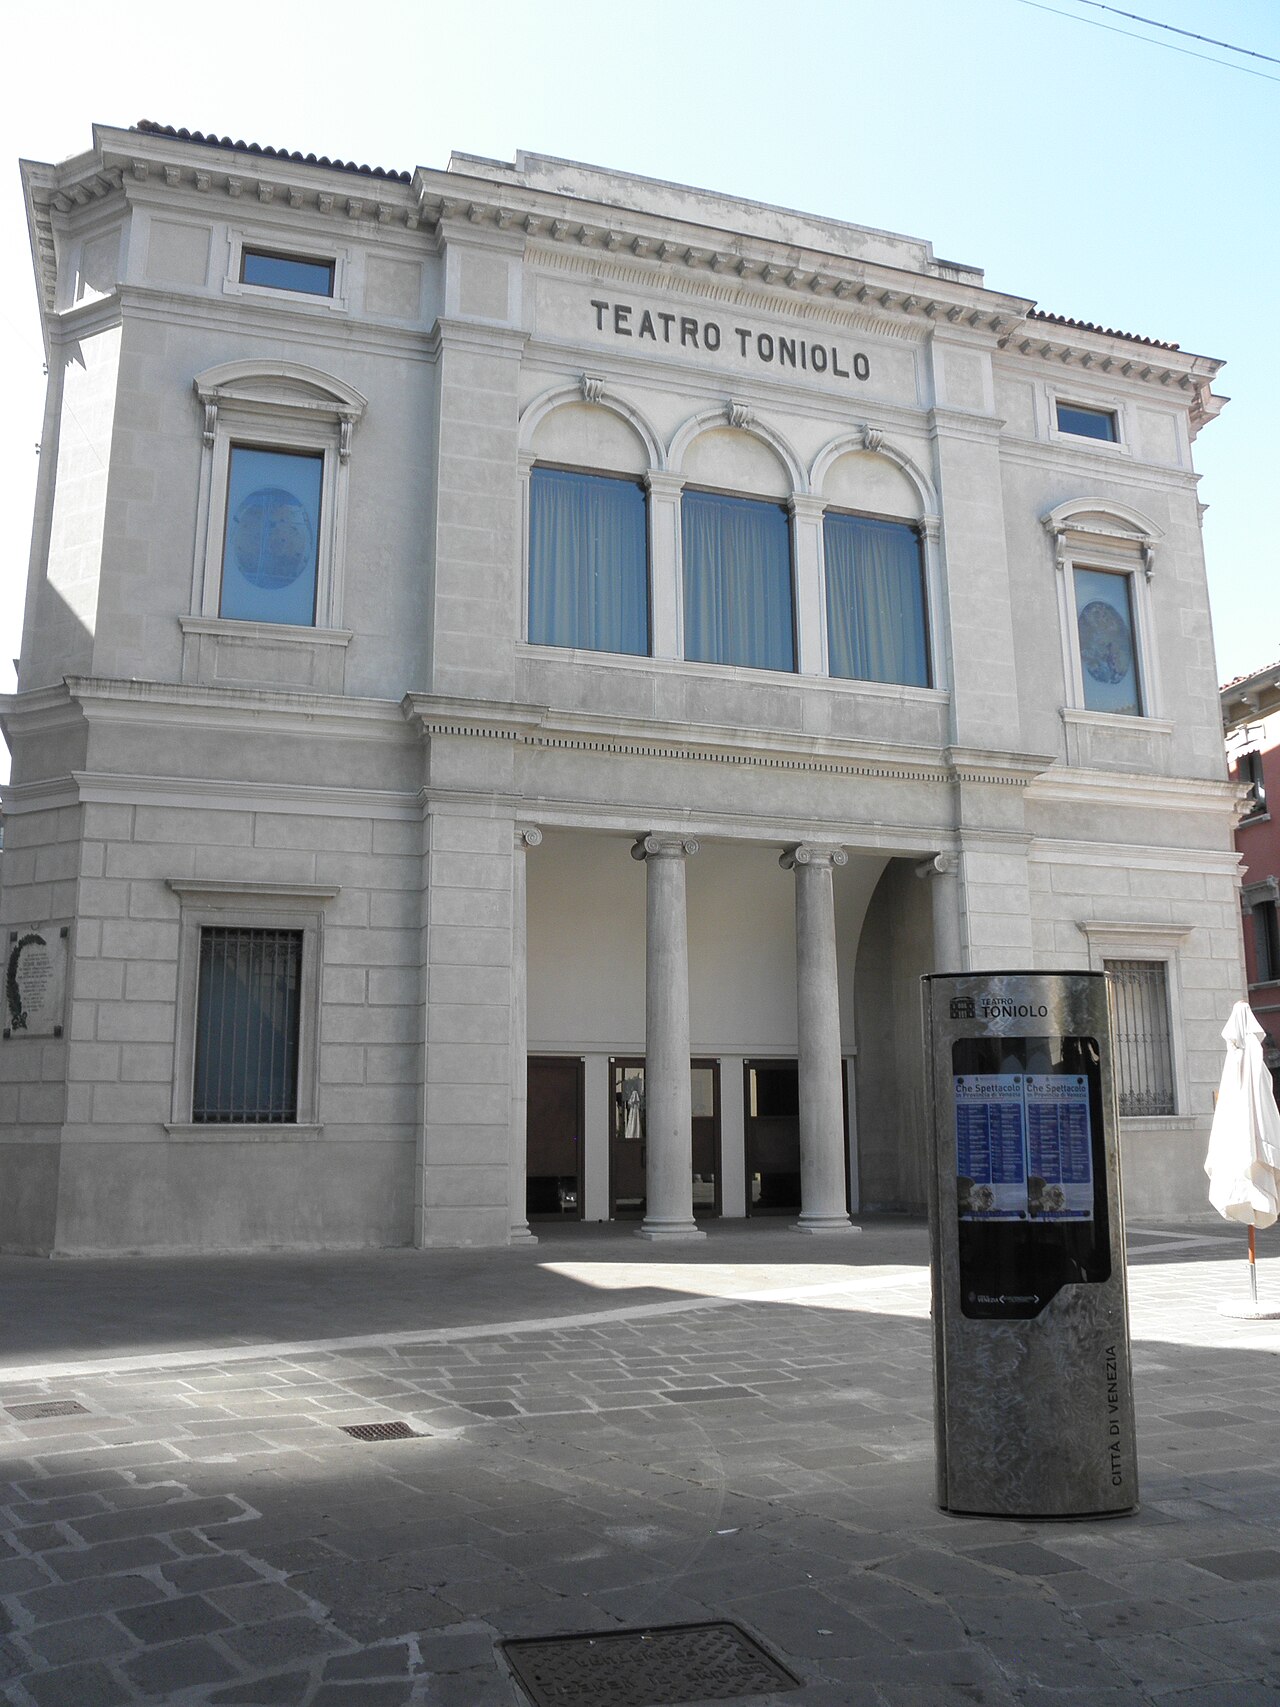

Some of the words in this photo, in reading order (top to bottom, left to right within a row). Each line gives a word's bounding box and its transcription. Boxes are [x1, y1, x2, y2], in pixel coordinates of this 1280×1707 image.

[590, 299, 721, 351] TEATRO
[734, 327, 871, 381] TONIOLO
[981, 1005, 1048, 1017] TONIOLO
[955, 1085, 972, 1093] Che
[975, 1084, 1020, 1093] Spettacolo
[1027, 1084, 1044, 1093] Che
[1046, 1084, 1086, 1093] Spettacolo
[1106, 1345, 1119, 1414] VENEZIA
[1109, 1420, 1120, 1435] DI
[1108, 1441, 1122, 1486] CITTÀ
